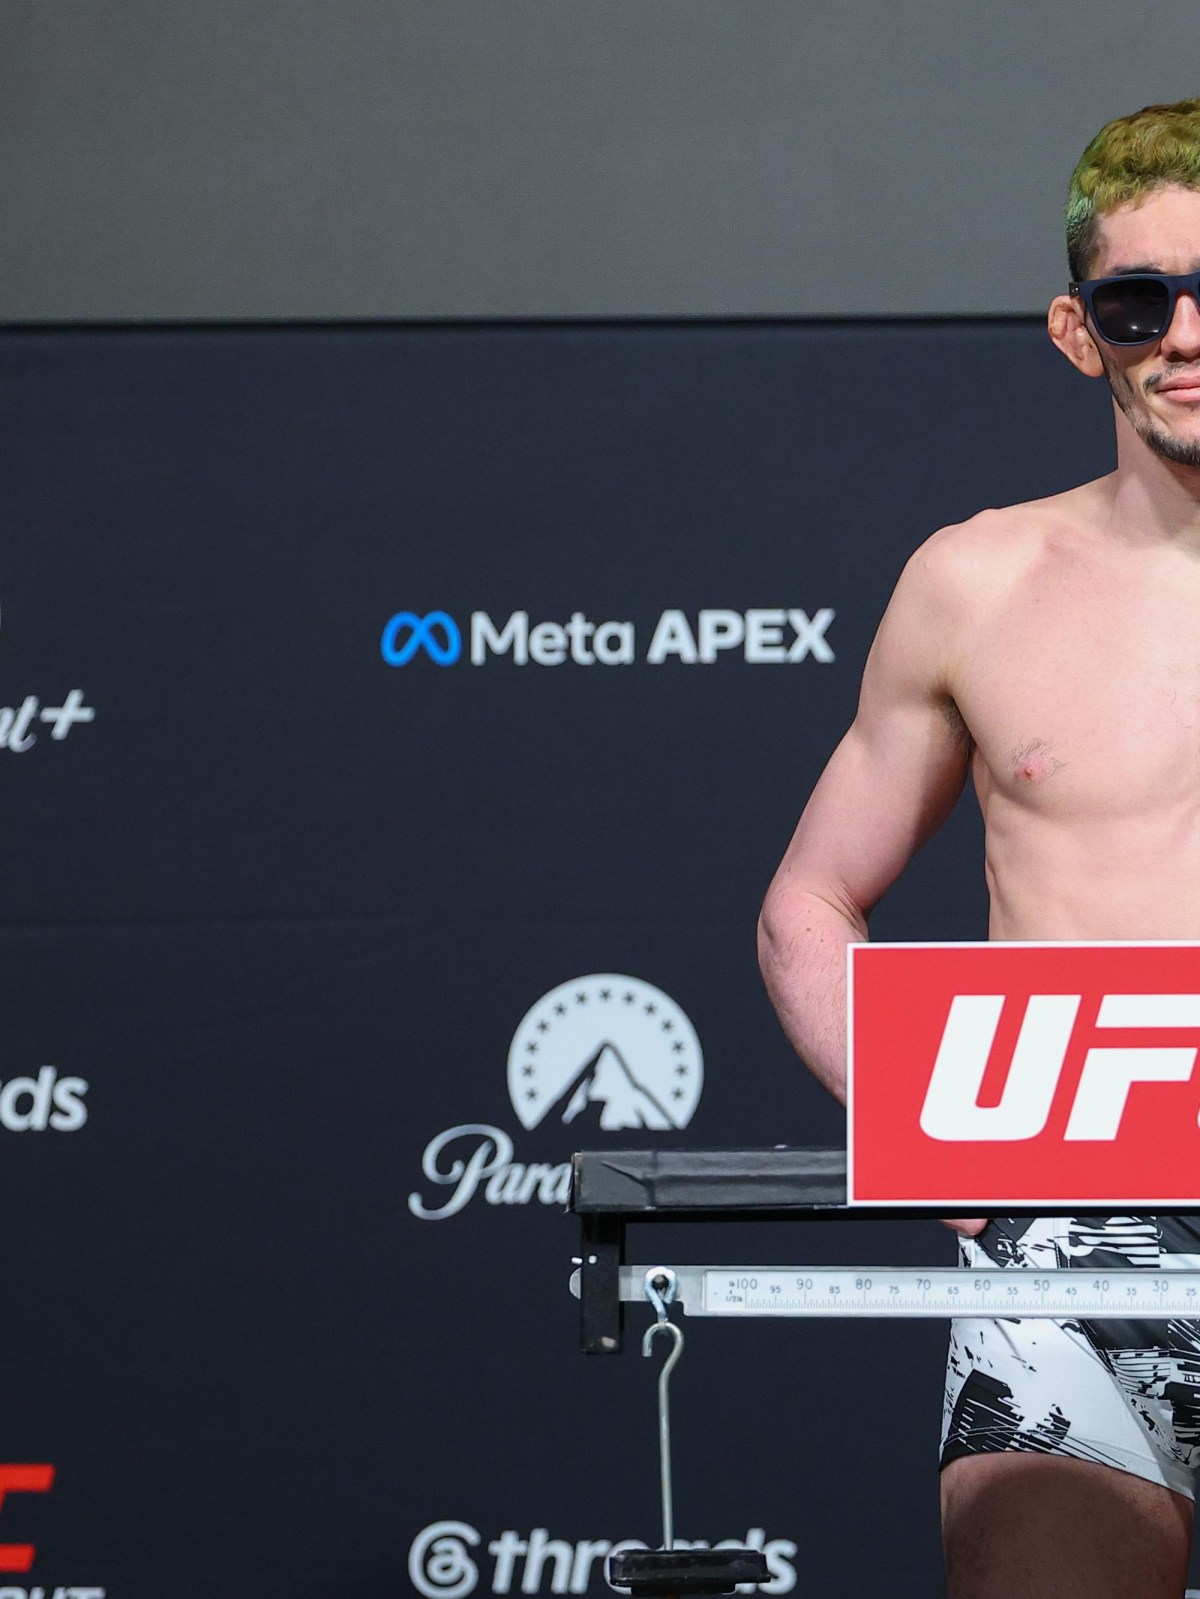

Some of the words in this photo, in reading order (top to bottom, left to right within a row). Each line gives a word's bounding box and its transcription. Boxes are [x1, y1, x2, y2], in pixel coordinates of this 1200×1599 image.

[470, 611, 634, 666] Meta
[647, 609, 835, 664] APEX
[736, 1278, 758, 1290] 100
[796, 1278, 813, 1290] 90
[855, 1278, 872, 1290] 80
[916, 1279, 931, 1291] 70
[974, 1279, 991, 1291] 60
[1033, 1279, 1050, 1291] 50
[1093, 1280, 1110, 1292] 40
[1152, 1280, 1169, 1292] 30
[769, 1285, 781, 1294] 95
[829, 1286, 840, 1294] 85
[889, 1286, 900, 1295] 75
[947, 1286, 959, 1295] 65
[1006, 1287, 1018, 1295] 55
[1065, 1287, 1077, 1295] 45
[1126, 1287, 1137, 1296] 35
[1185, 1288, 1197, 1296] 25
